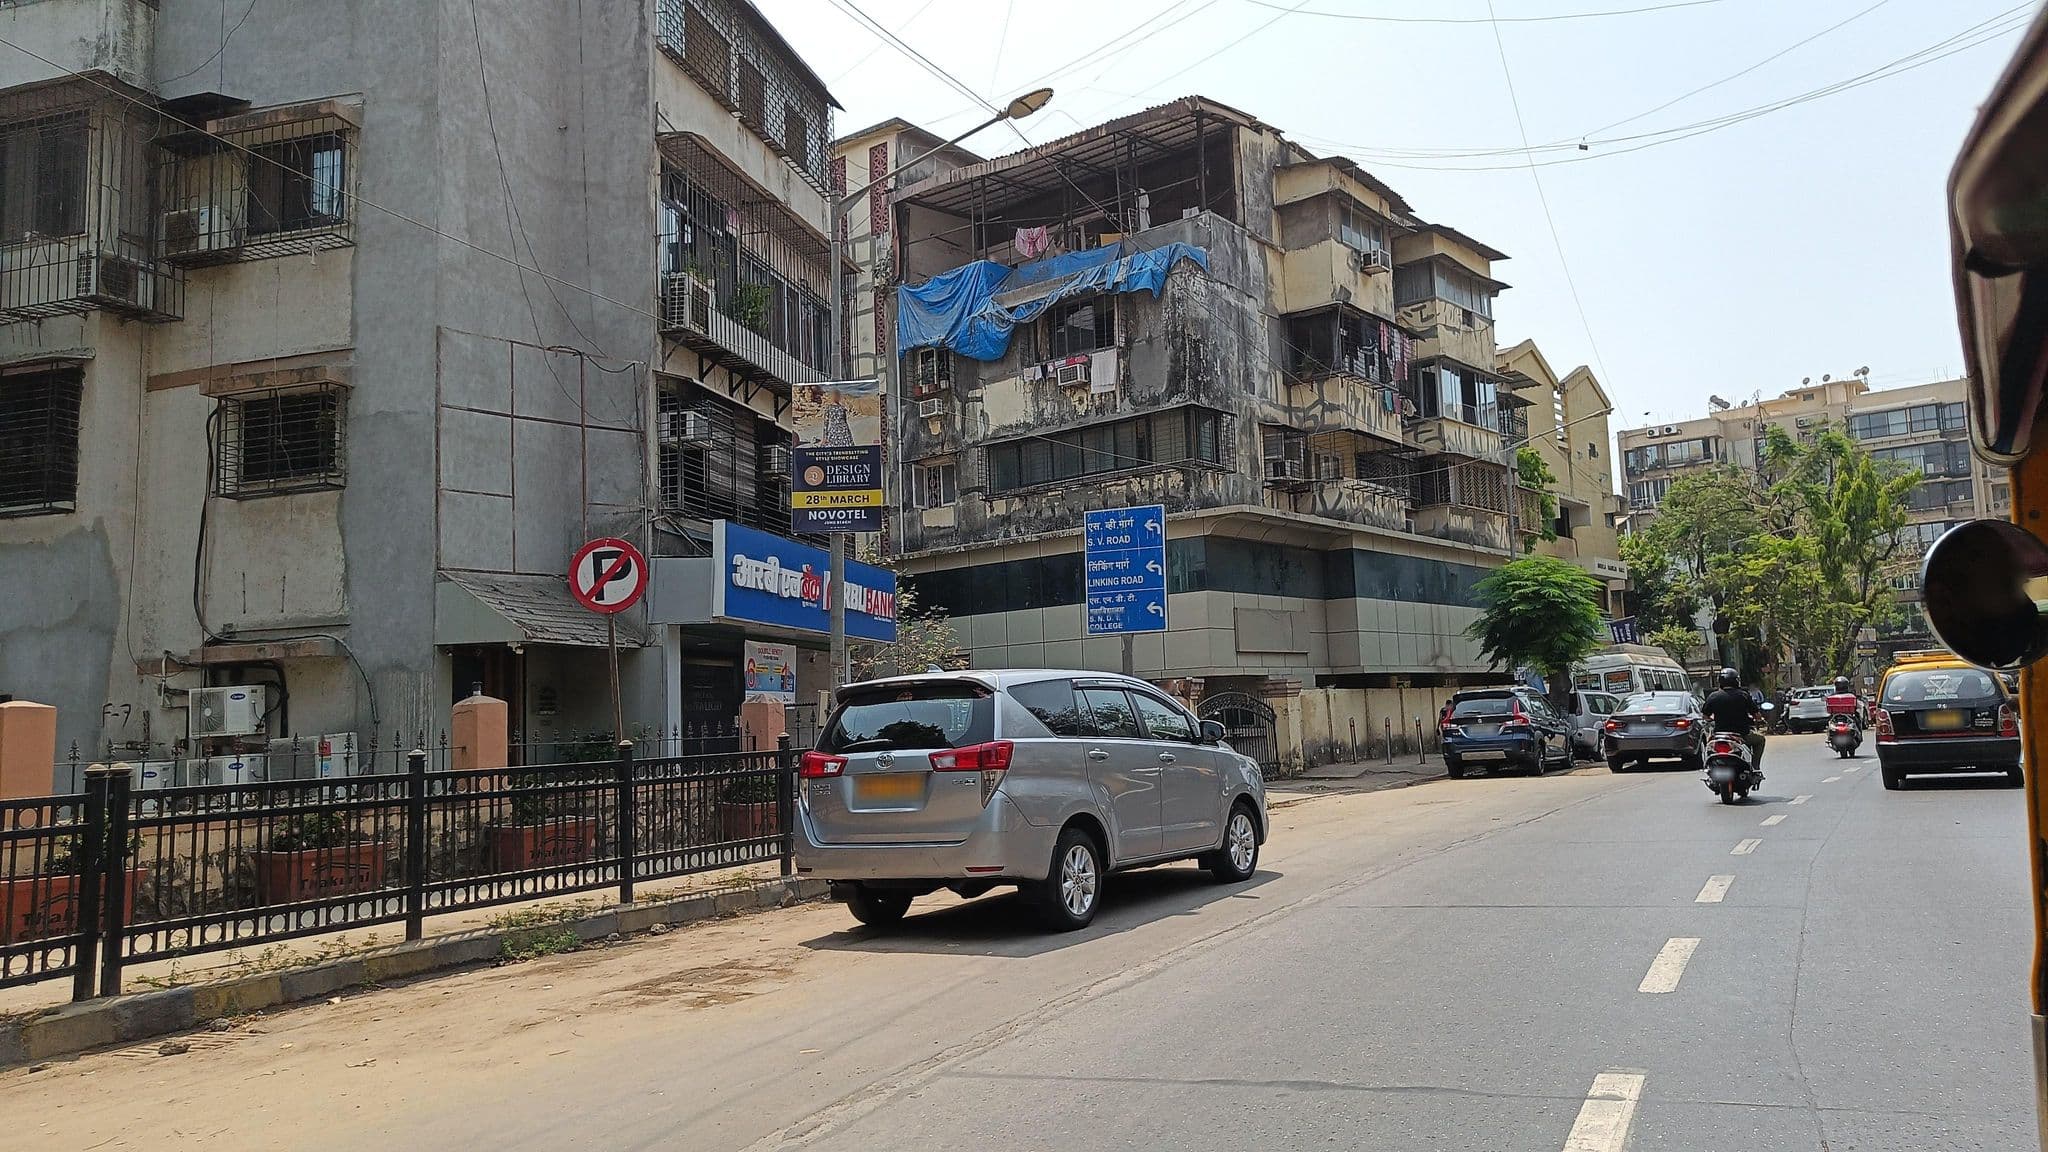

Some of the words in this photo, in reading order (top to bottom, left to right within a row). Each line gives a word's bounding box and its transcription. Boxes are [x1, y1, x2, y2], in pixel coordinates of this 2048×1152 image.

[826, 463, 871, 475] DESIGN
[826, 474, 870, 484] LIBRARY
[830, 494, 870, 504] MARCH
[808, 509, 867, 521] NOVOTEL
[1106, 535, 1131, 545] ROAD
[592, 550, 632, 601] P
[1088, 577, 1120, 588] LINKING
[1120, 575, 1144, 585] ROAD
